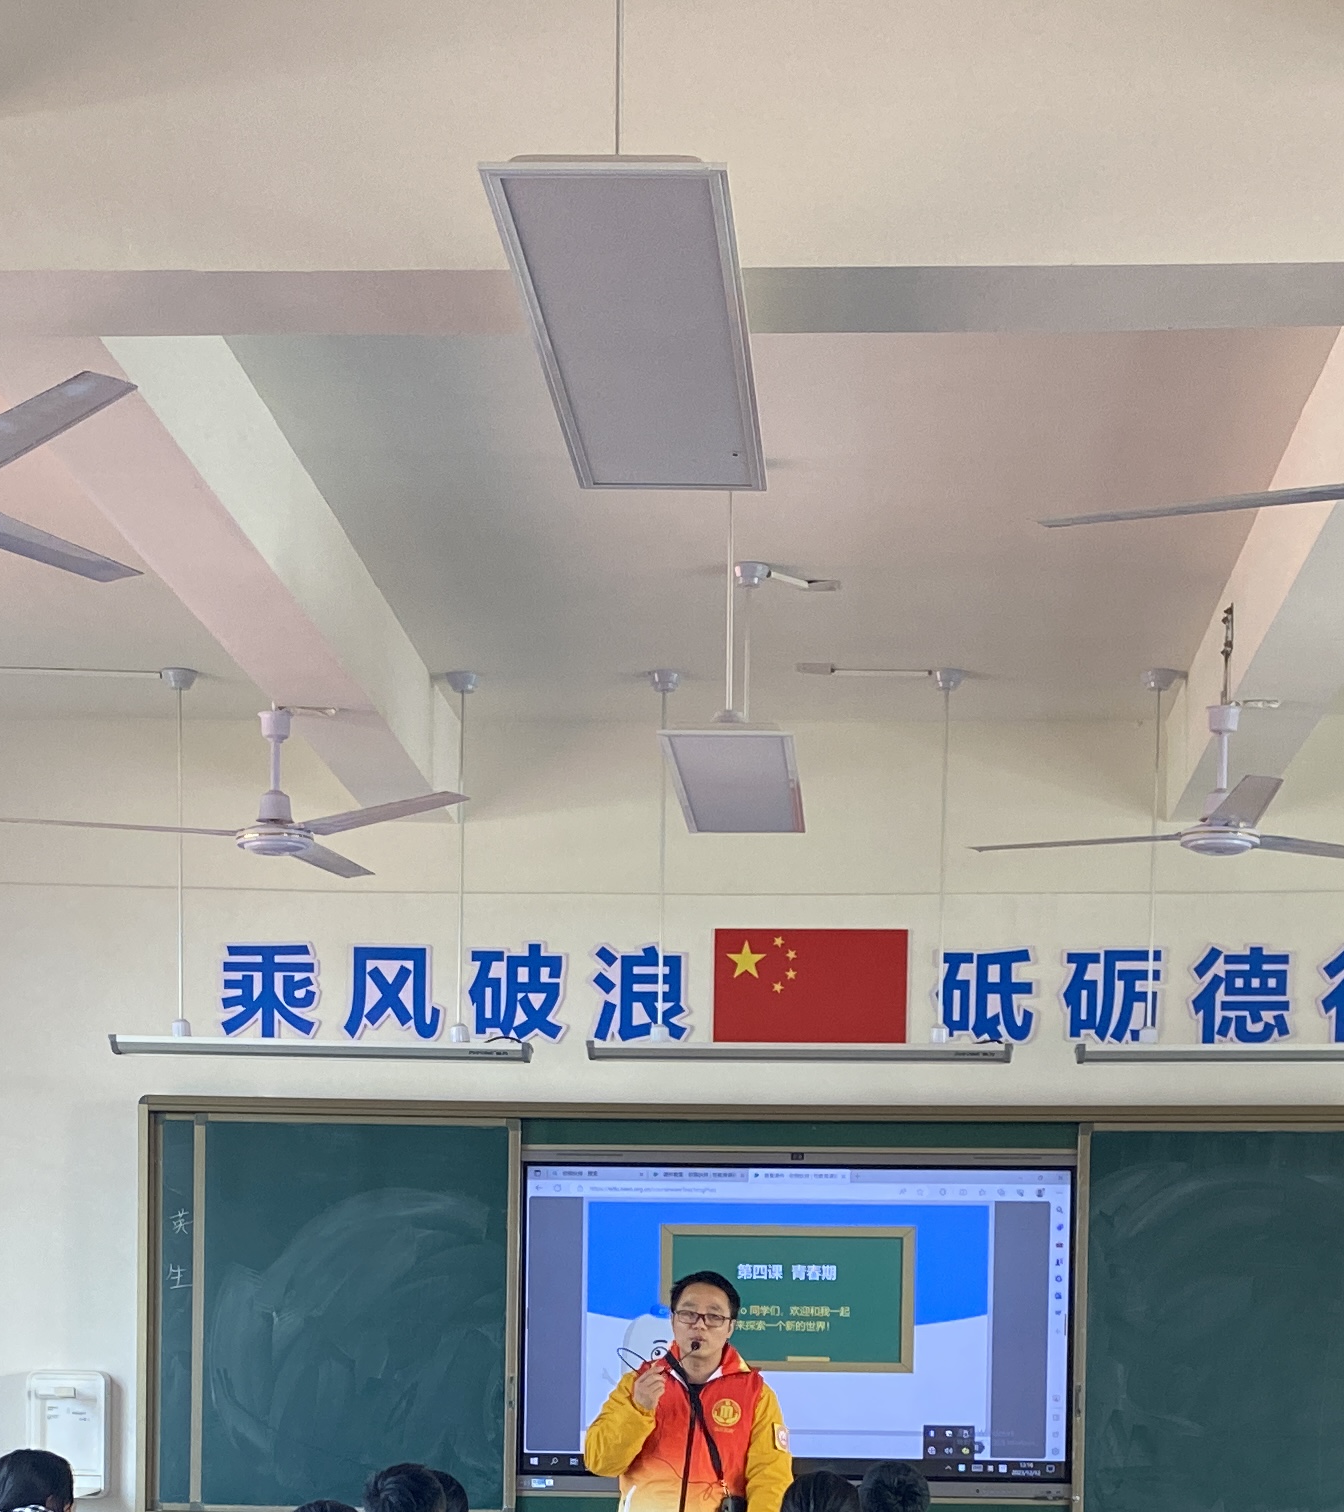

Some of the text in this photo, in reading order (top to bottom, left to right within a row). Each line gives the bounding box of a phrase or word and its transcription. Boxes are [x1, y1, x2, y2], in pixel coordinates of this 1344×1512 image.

[221, 943, 687, 1041] 乘风破浪
[166, 1263, 193, 1290] 生
[737, 1263, 837, 1281] 第四课 青春期
